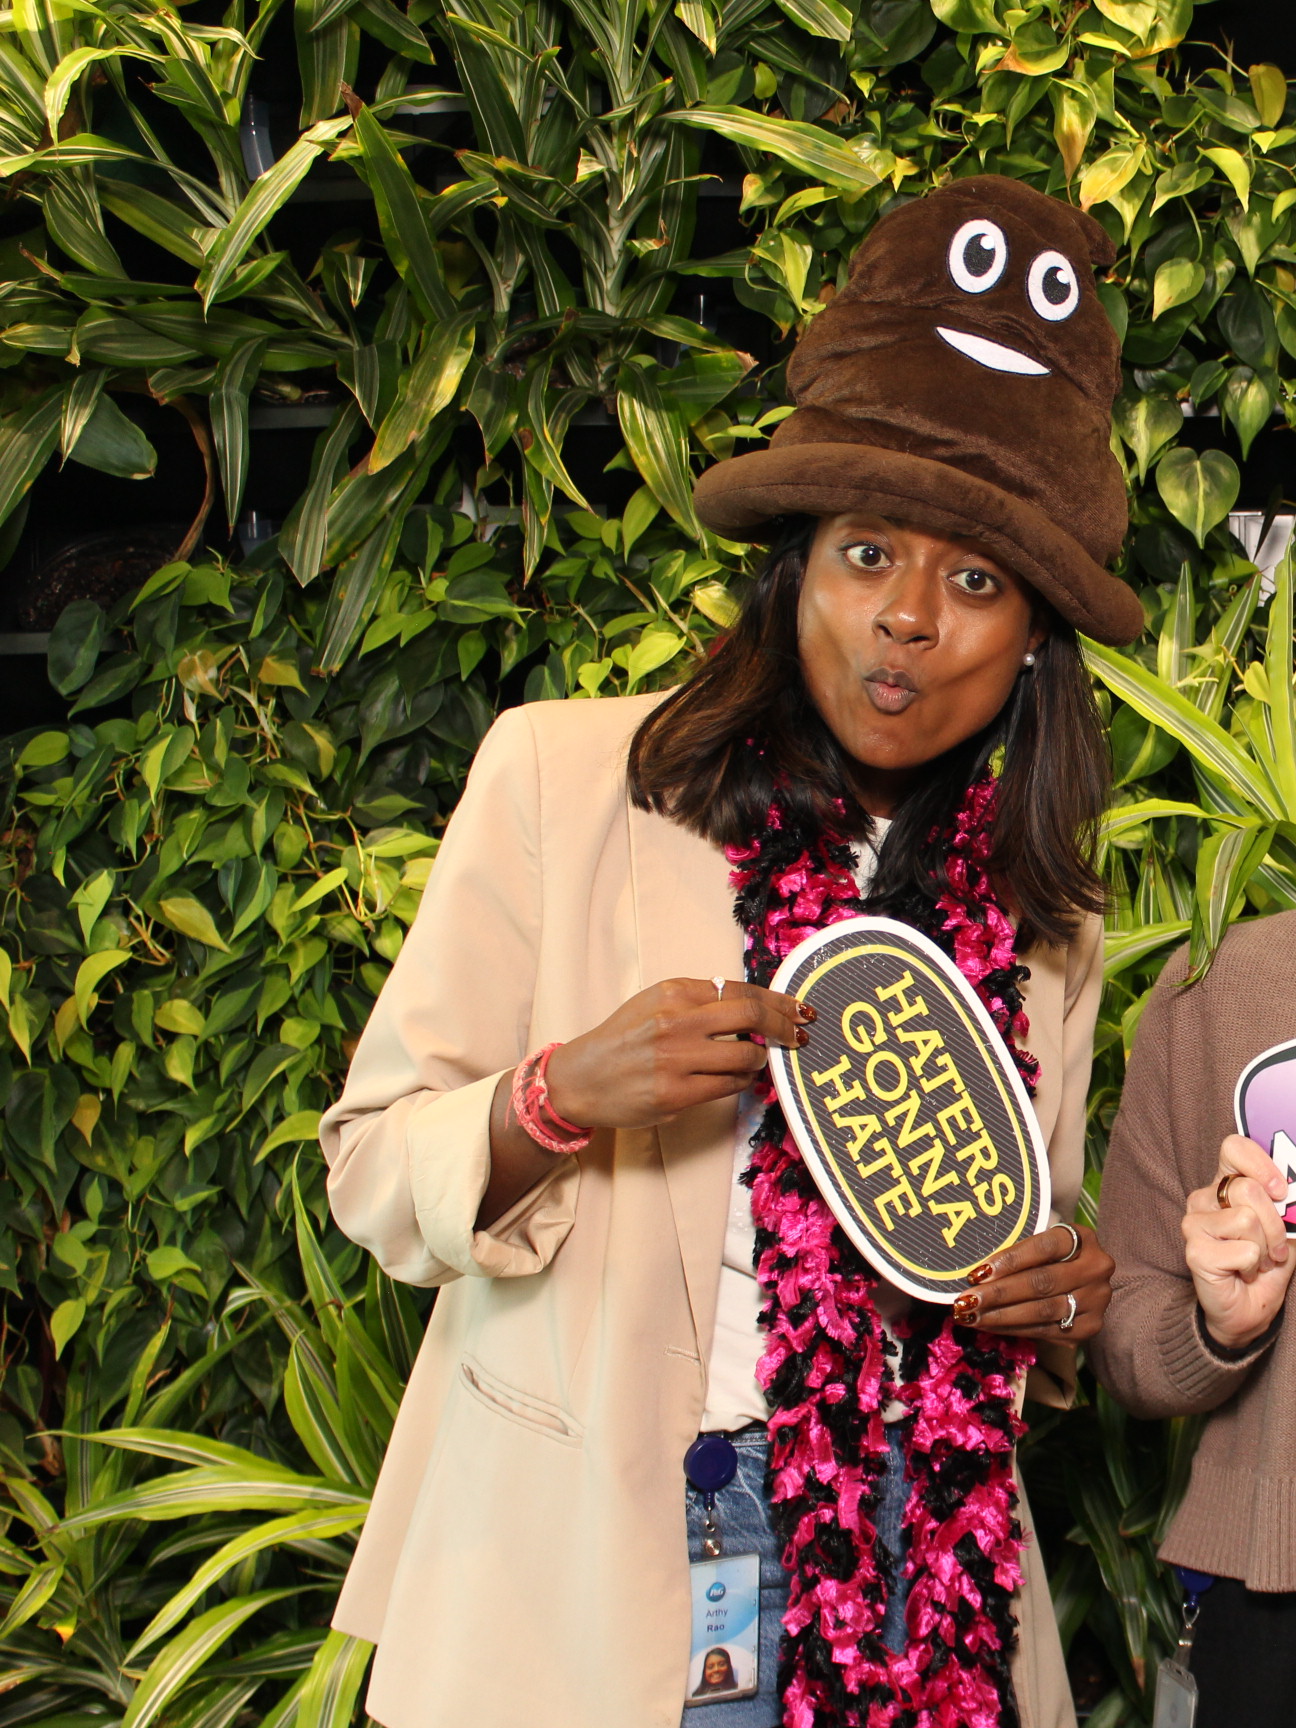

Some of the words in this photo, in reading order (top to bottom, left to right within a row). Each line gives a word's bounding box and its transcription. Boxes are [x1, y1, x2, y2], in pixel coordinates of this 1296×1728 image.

[811, 1054, 922, 1232] HATE
[841, 1001, 977, 1248] GONNA
[875, 970, 1016, 1217] HATERS
[706, 1609, 728, 1619] Arthy
[707, 1624, 725, 1632] Rao
